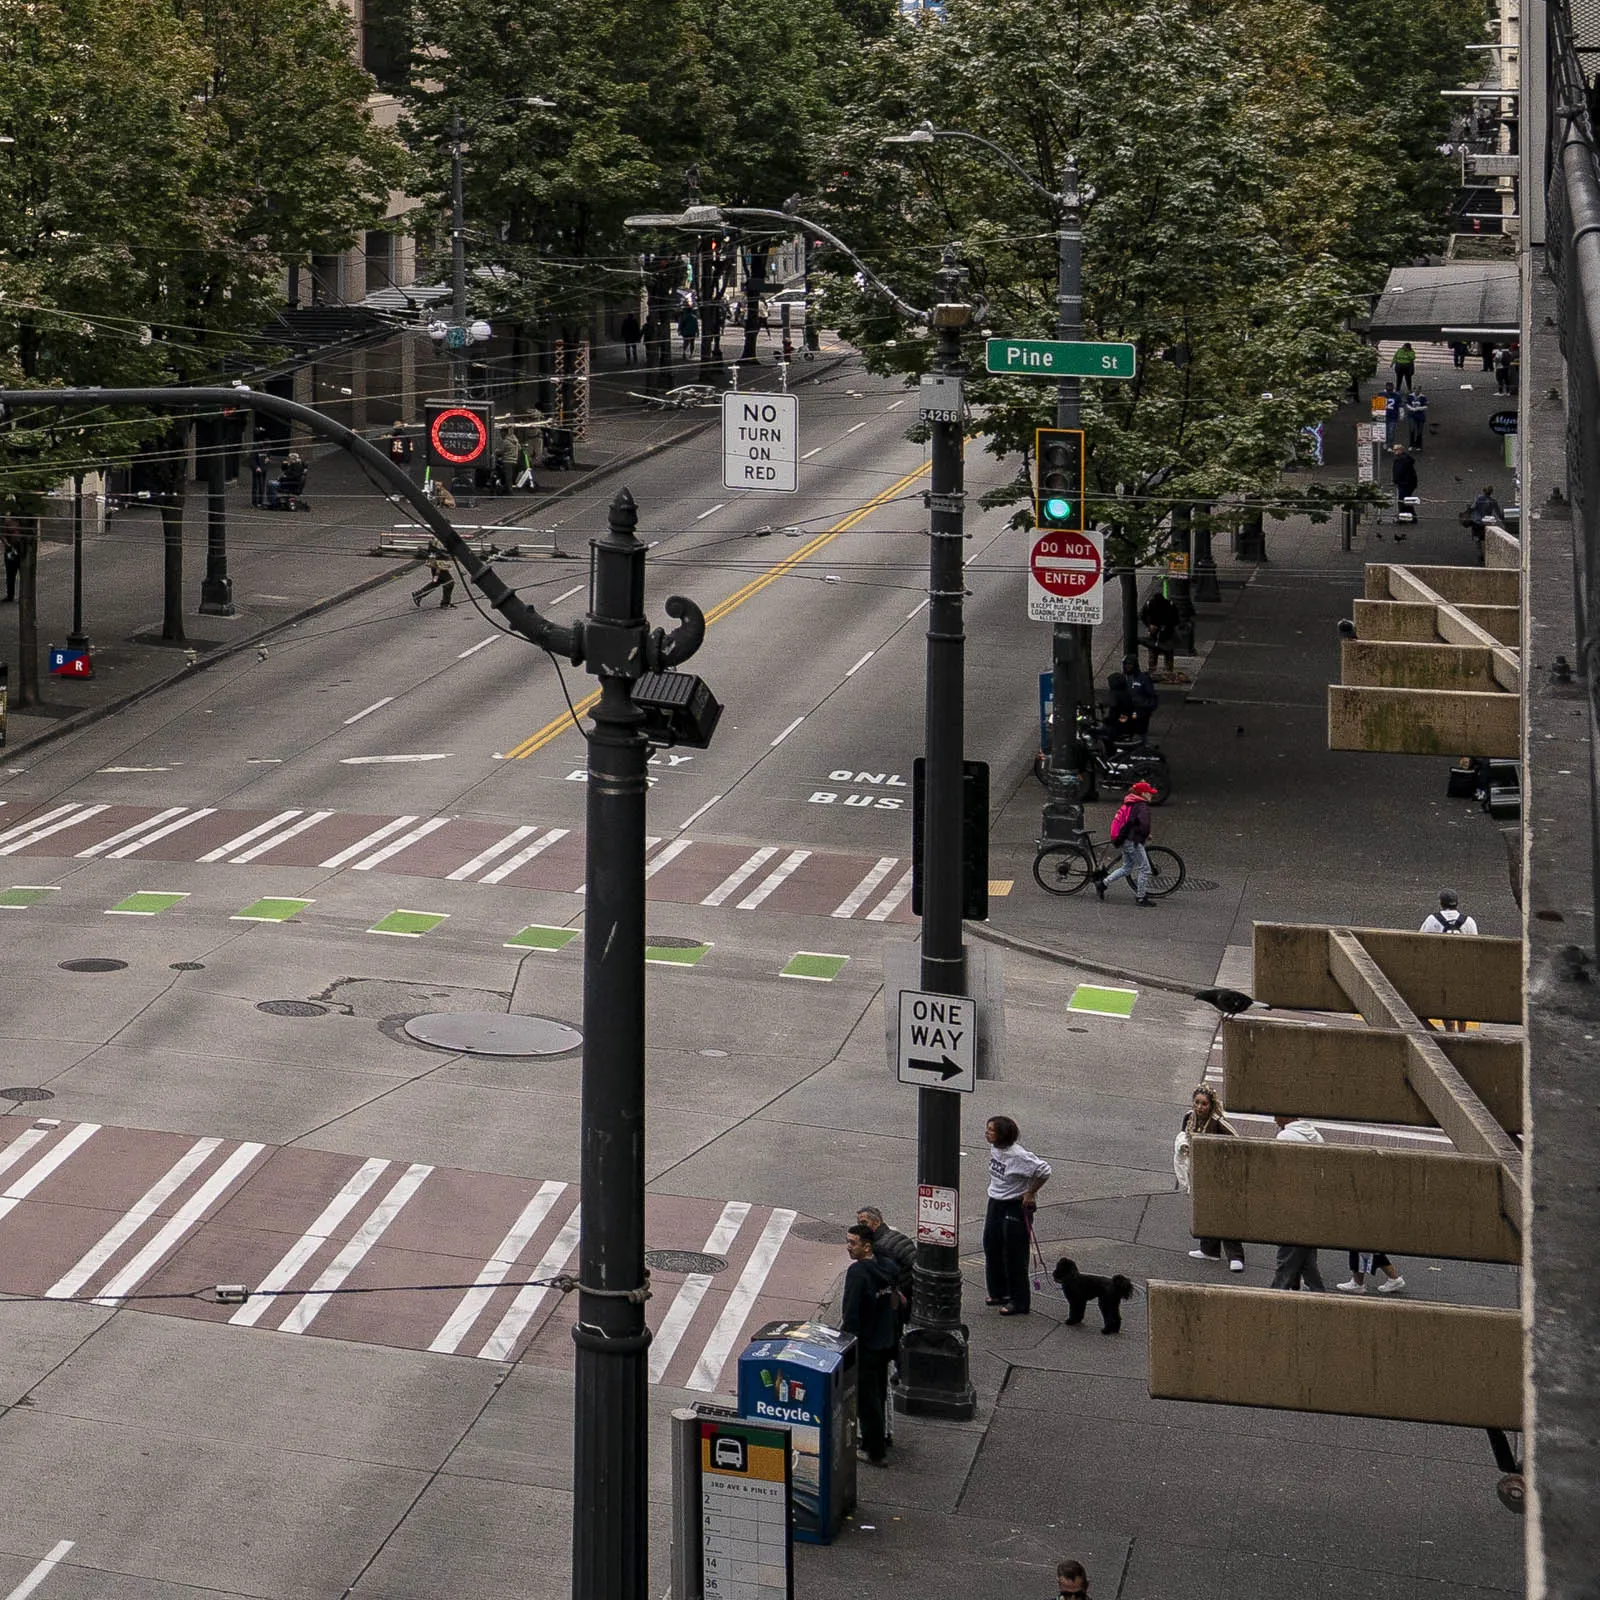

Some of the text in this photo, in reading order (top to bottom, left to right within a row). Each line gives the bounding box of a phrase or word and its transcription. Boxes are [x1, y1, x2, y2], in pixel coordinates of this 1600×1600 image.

[1007, 346, 1118, 370] Pine St
[743, 403, 777, 423] NO
[920, 409, 957, 422] 54266
[739, 426, 781, 442] TURN
[749, 447, 771, 461] ON
[744, 465, 776, 481] RED
[1040, 542, 1092, 555] DO NOT
[1045, 572, 1087, 585] ENTER
[1031, 609, 1056, 617] LOADING
[56, 654, 83, 671] B R
[829, 769, 907, 787] ONL
[808, 791, 905, 810] BUS
[912, 1001, 963, 1026] ONE
[910, 1026, 964, 1052] WAY
[922, 1199, 952, 1212] STOPS
[757, 1401, 811, 1422] Recycle
[727, 1483, 740, 1491] AVE
[751, 1487, 767, 1496] PINE
[704, 1494, 710, 1504] 2
[705, 1516, 711, 1525] 4
[705, 1536, 711, 1545] 7
[705, 1558, 717, 1568] 14
[705, 1578, 718, 1589] 36
